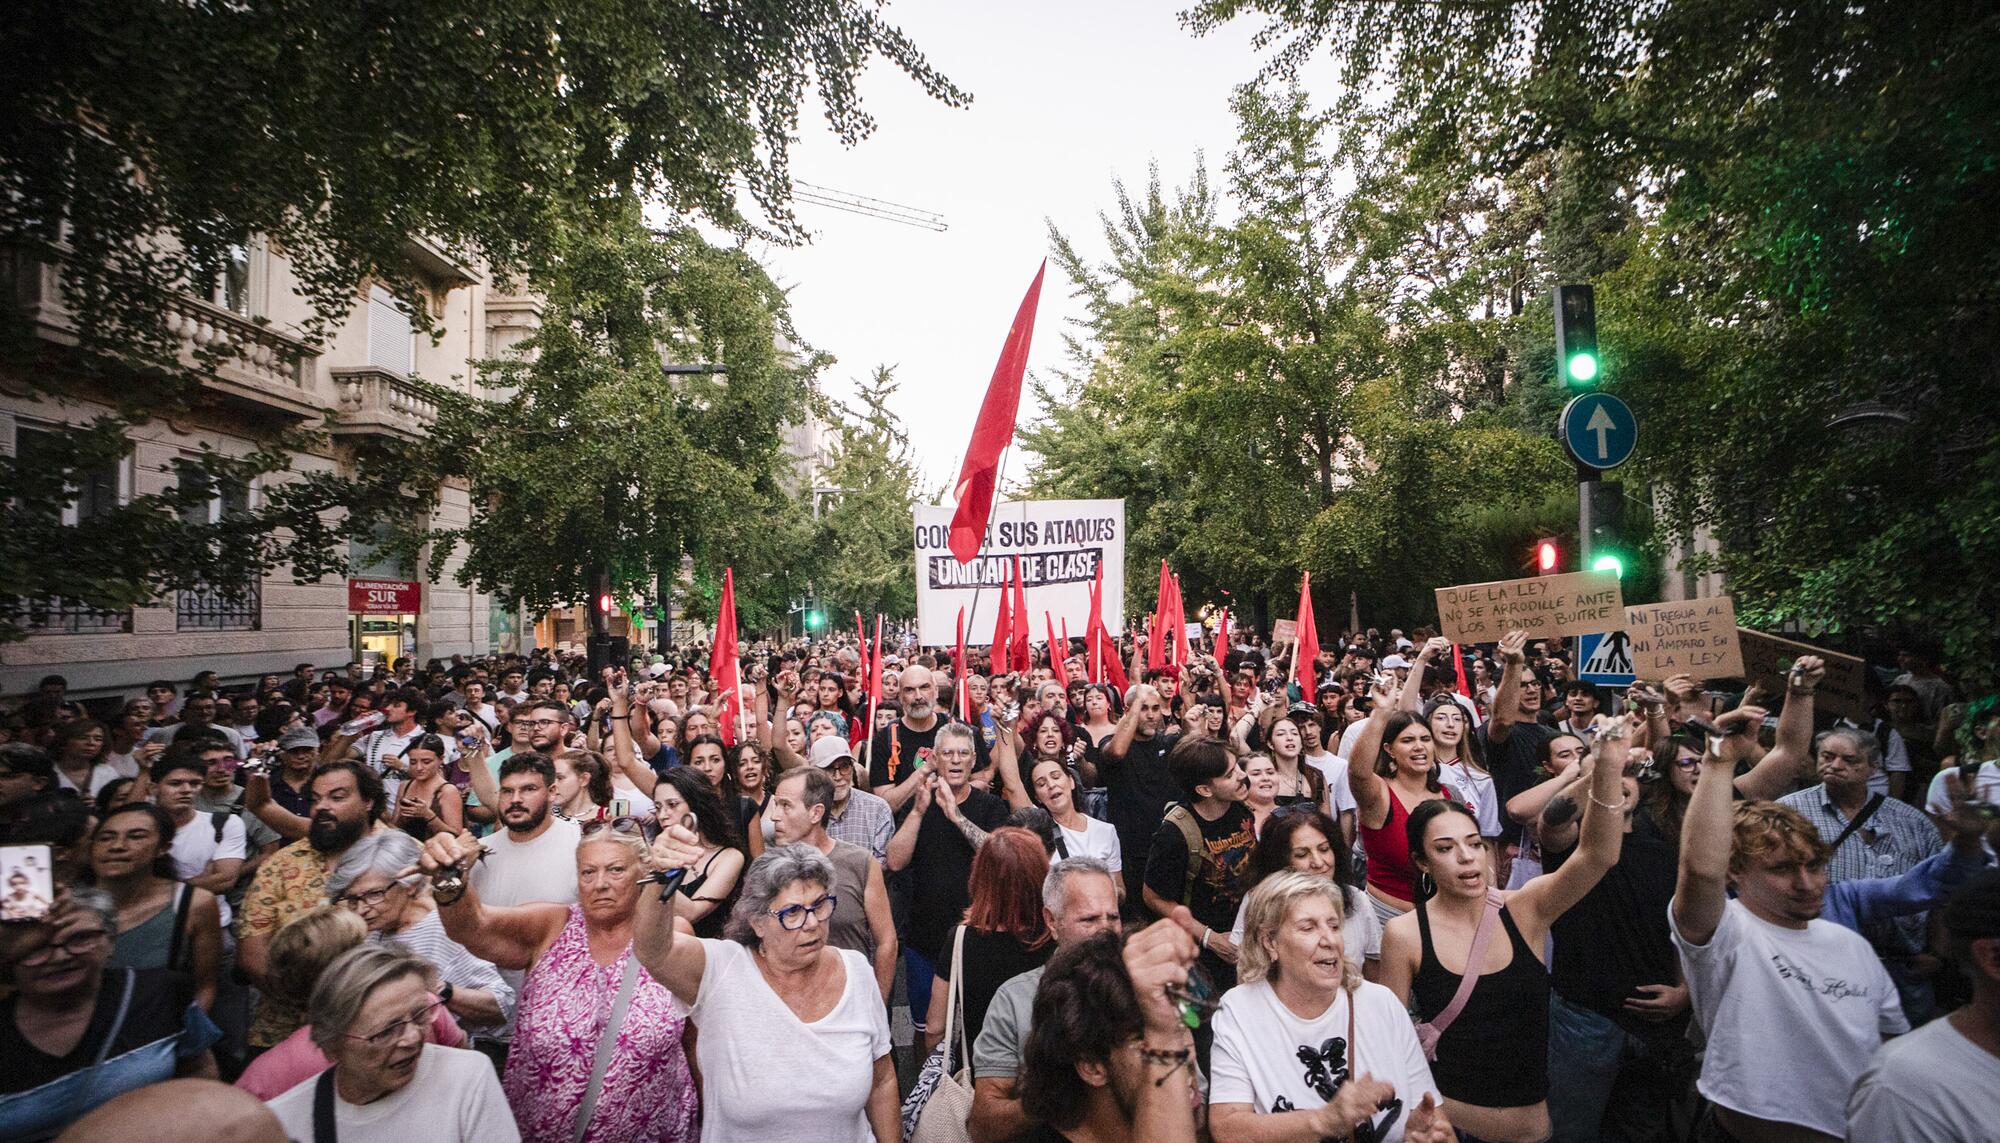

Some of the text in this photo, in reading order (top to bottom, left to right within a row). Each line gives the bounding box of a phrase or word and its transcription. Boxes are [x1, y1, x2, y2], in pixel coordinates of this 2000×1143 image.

[916, 518, 1115, 549] CONA SUS ATAQUES
[937, 552, 1095, 585] UNIDAD DE CLASE
[354, 582, 409, 591] ALIMENTACIÓN
[367, 590, 397, 603] SUR
[1447, 582, 1548, 604] QUE LA LEY
[1445, 609, 1463, 621] NO
[1468, 607, 1484, 617] SE
[1576, 590, 1616, 606] ANTE
[1631, 611, 1647, 625] NI
[1706, 606, 1722, 616] AL
[1458, 621, 1485, 634] LOS
[1555, 606, 1613, 625] BUITRE
[1634, 641, 1650, 652] NI
[1656, 638, 1705, 650] AMPARO
[1655, 652, 1726, 668] LA LEY
